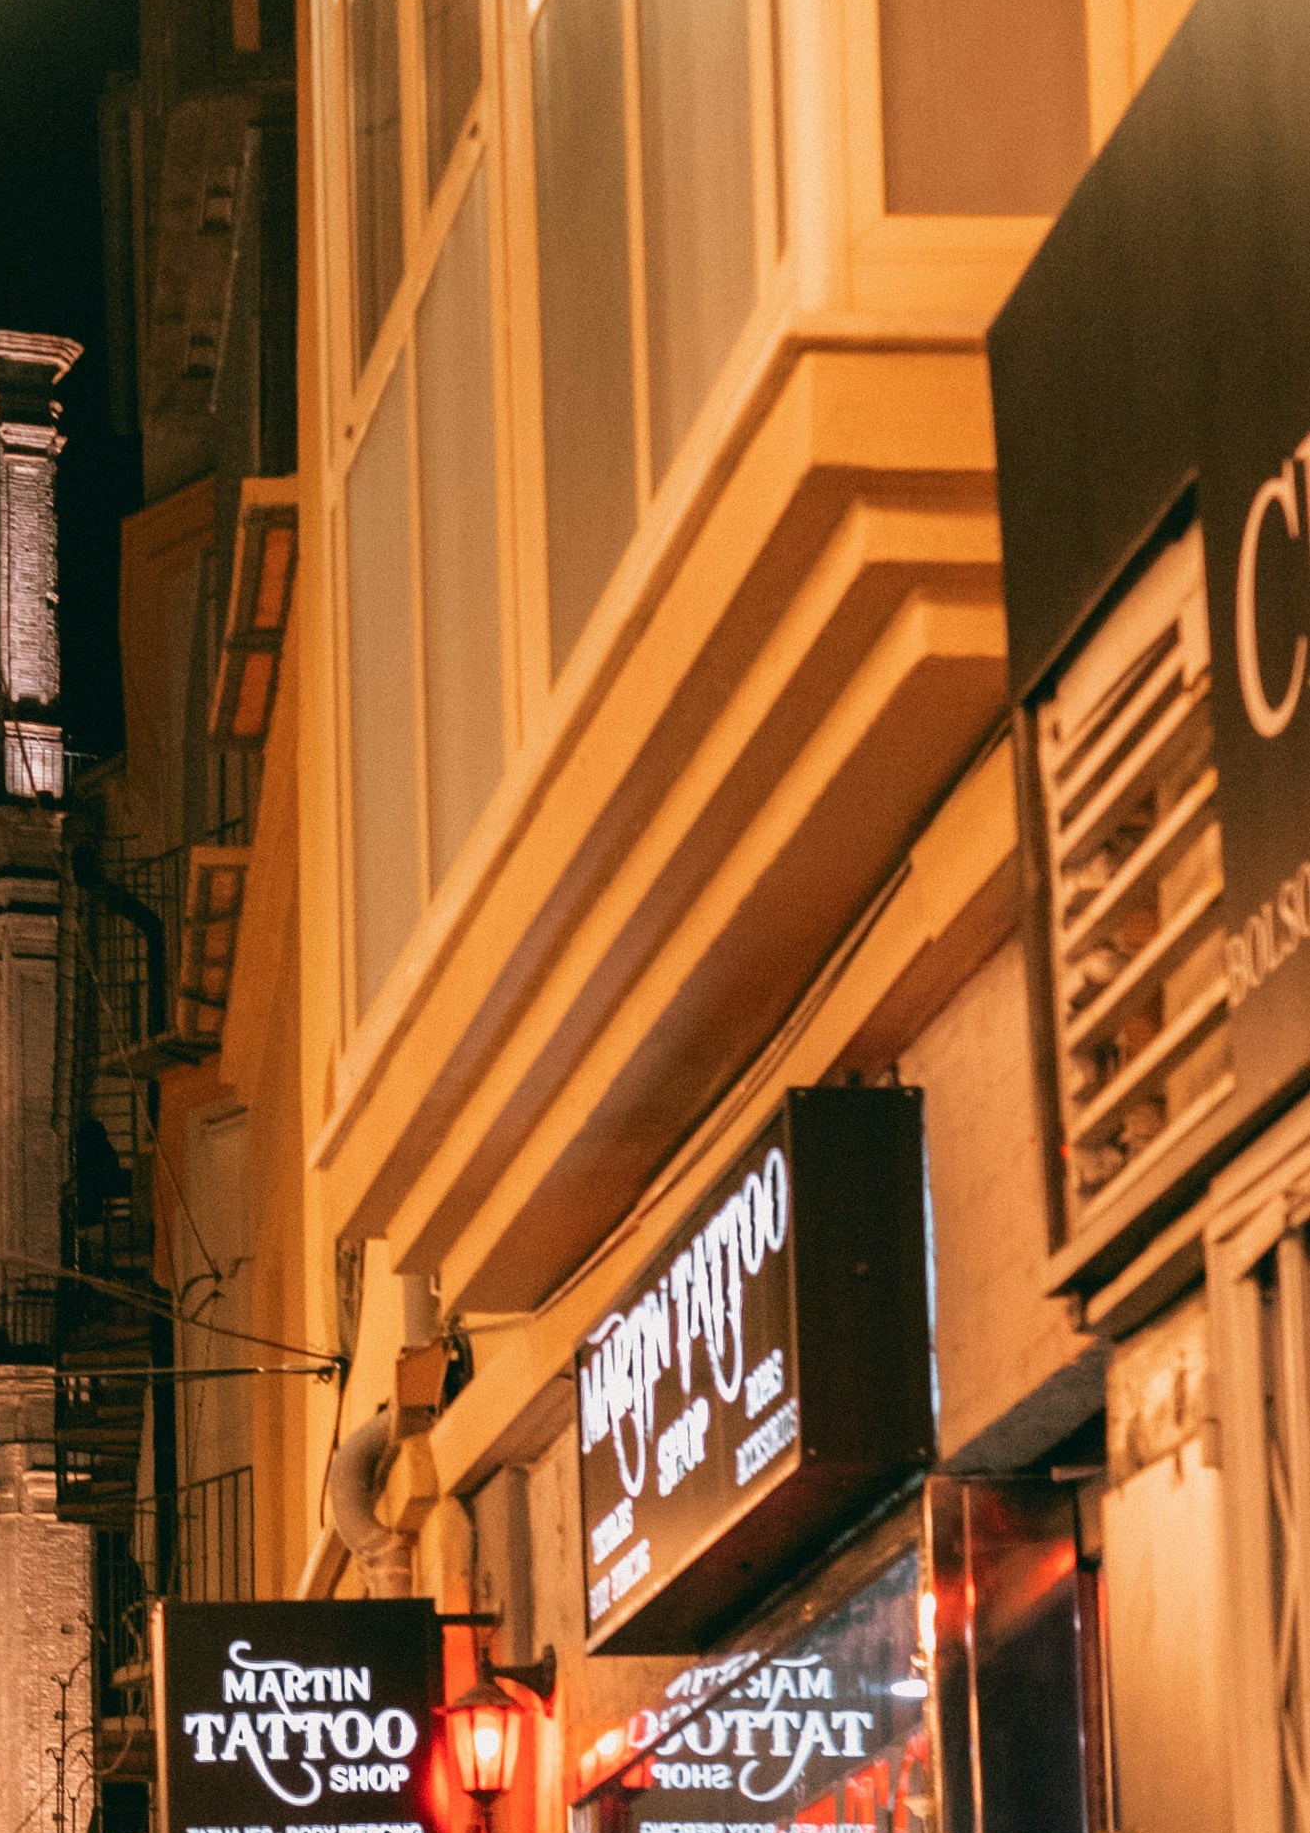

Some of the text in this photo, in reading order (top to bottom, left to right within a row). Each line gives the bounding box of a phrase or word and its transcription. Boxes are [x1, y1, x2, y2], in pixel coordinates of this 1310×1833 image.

[671, 1147, 789, 1403] TATTOO
[223, 1642, 371, 1710] MARTIN
[183, 1708, 418, 1803] TATTOO
[329, 1763, 410, 1793] SHOP
